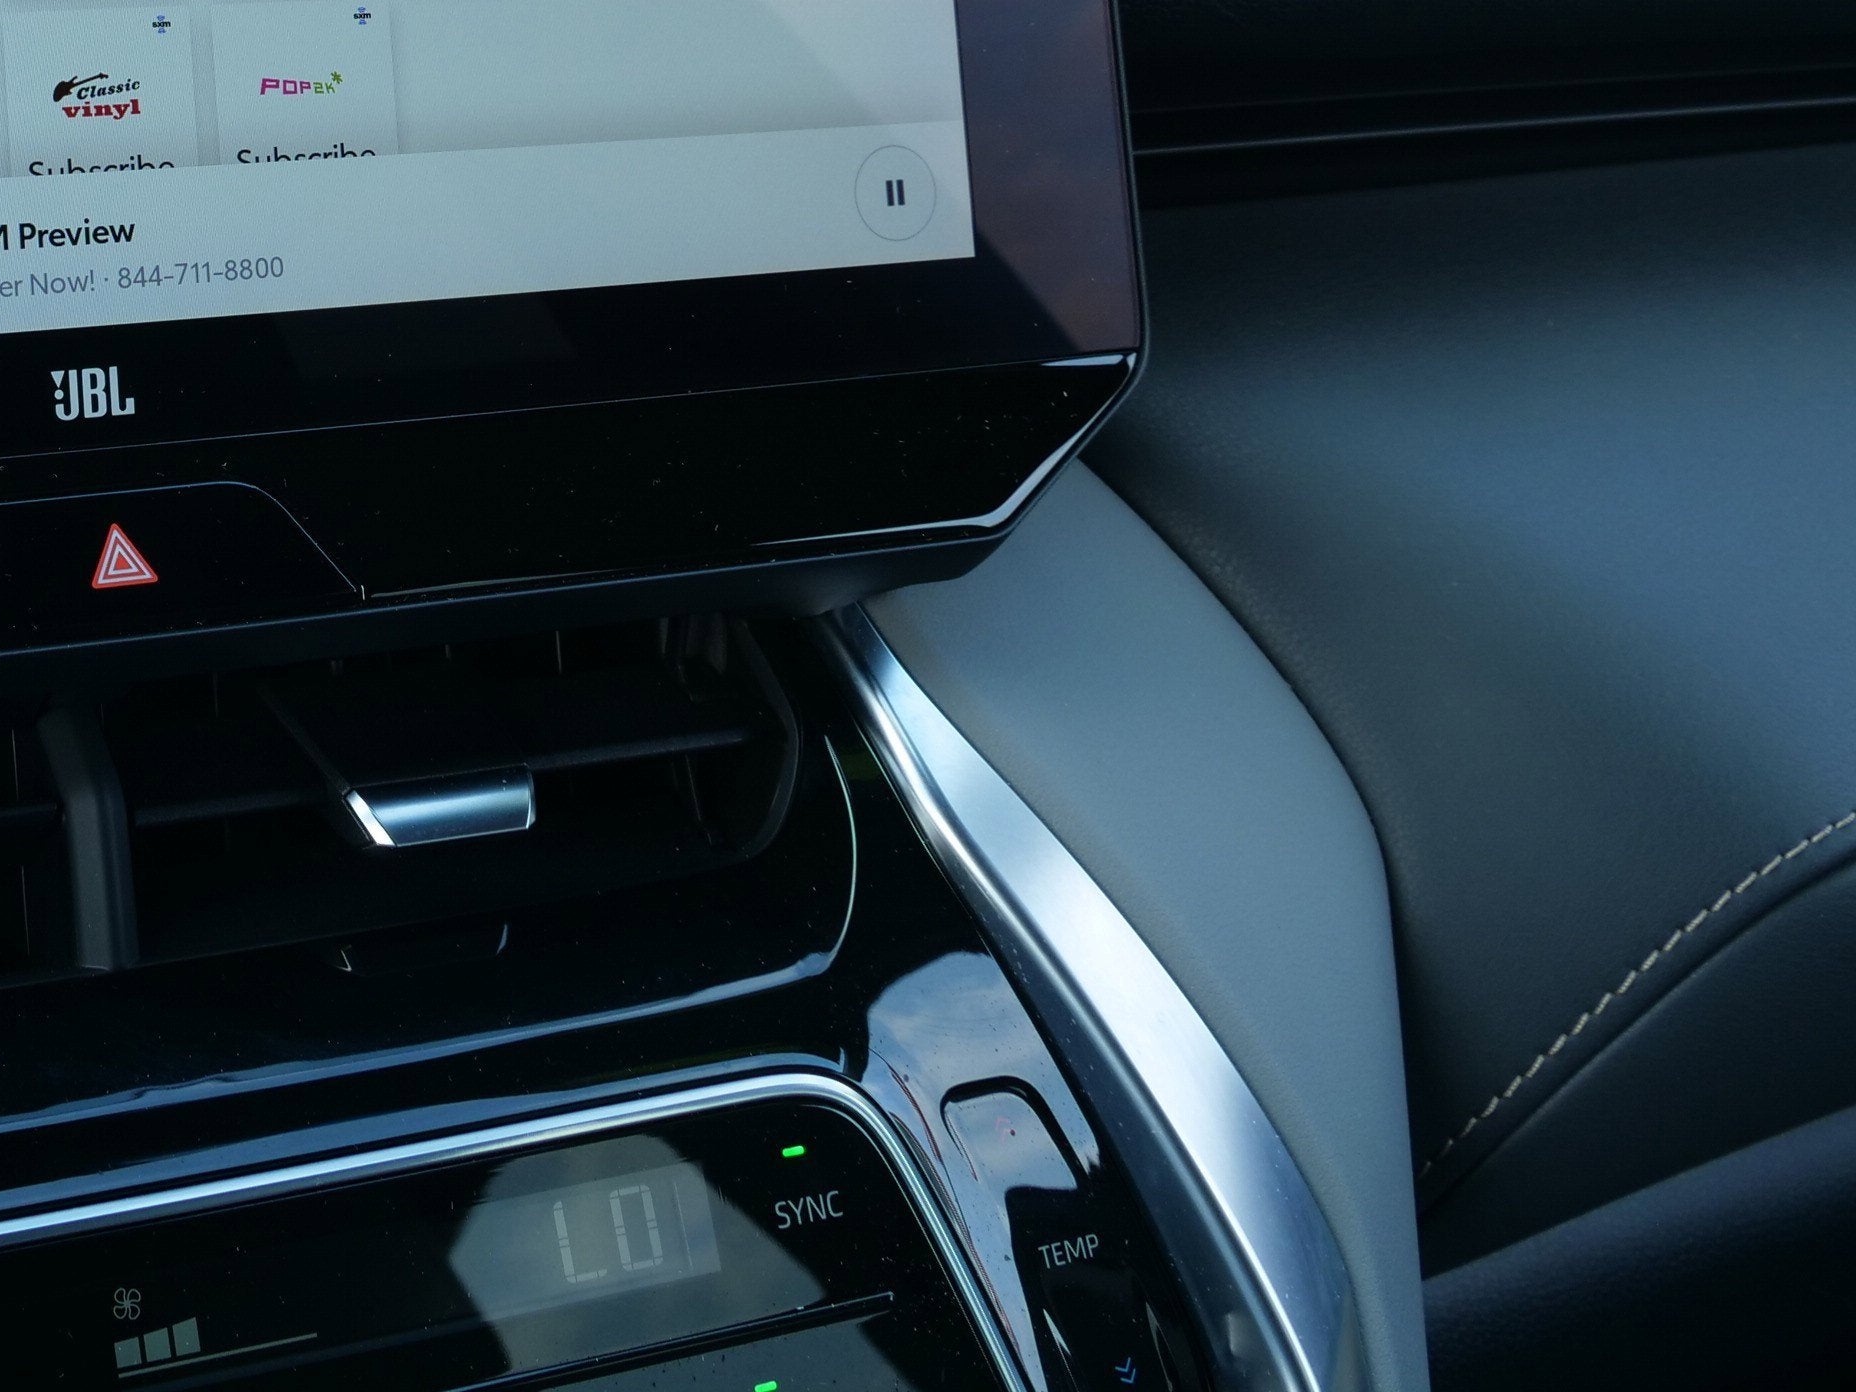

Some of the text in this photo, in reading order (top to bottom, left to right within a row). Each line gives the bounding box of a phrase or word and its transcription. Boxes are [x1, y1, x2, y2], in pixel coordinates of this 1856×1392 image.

[151, 20, 172, 28] sxm
[352, 11, 372, 20] sxm
[76, 78, 141, 101] Classic
[61, 98, 142, 121] vinyl
[18, 217, 137, 250] Preview
[29, 268, 97, 297] Now!
[117, 254, 286, 290] 844-711-8800
[50, 365, 136, 422] JBL
[774, 1190, 845, 1230] SYNC
[1038, 1233, 1101, 1271] TEMP
